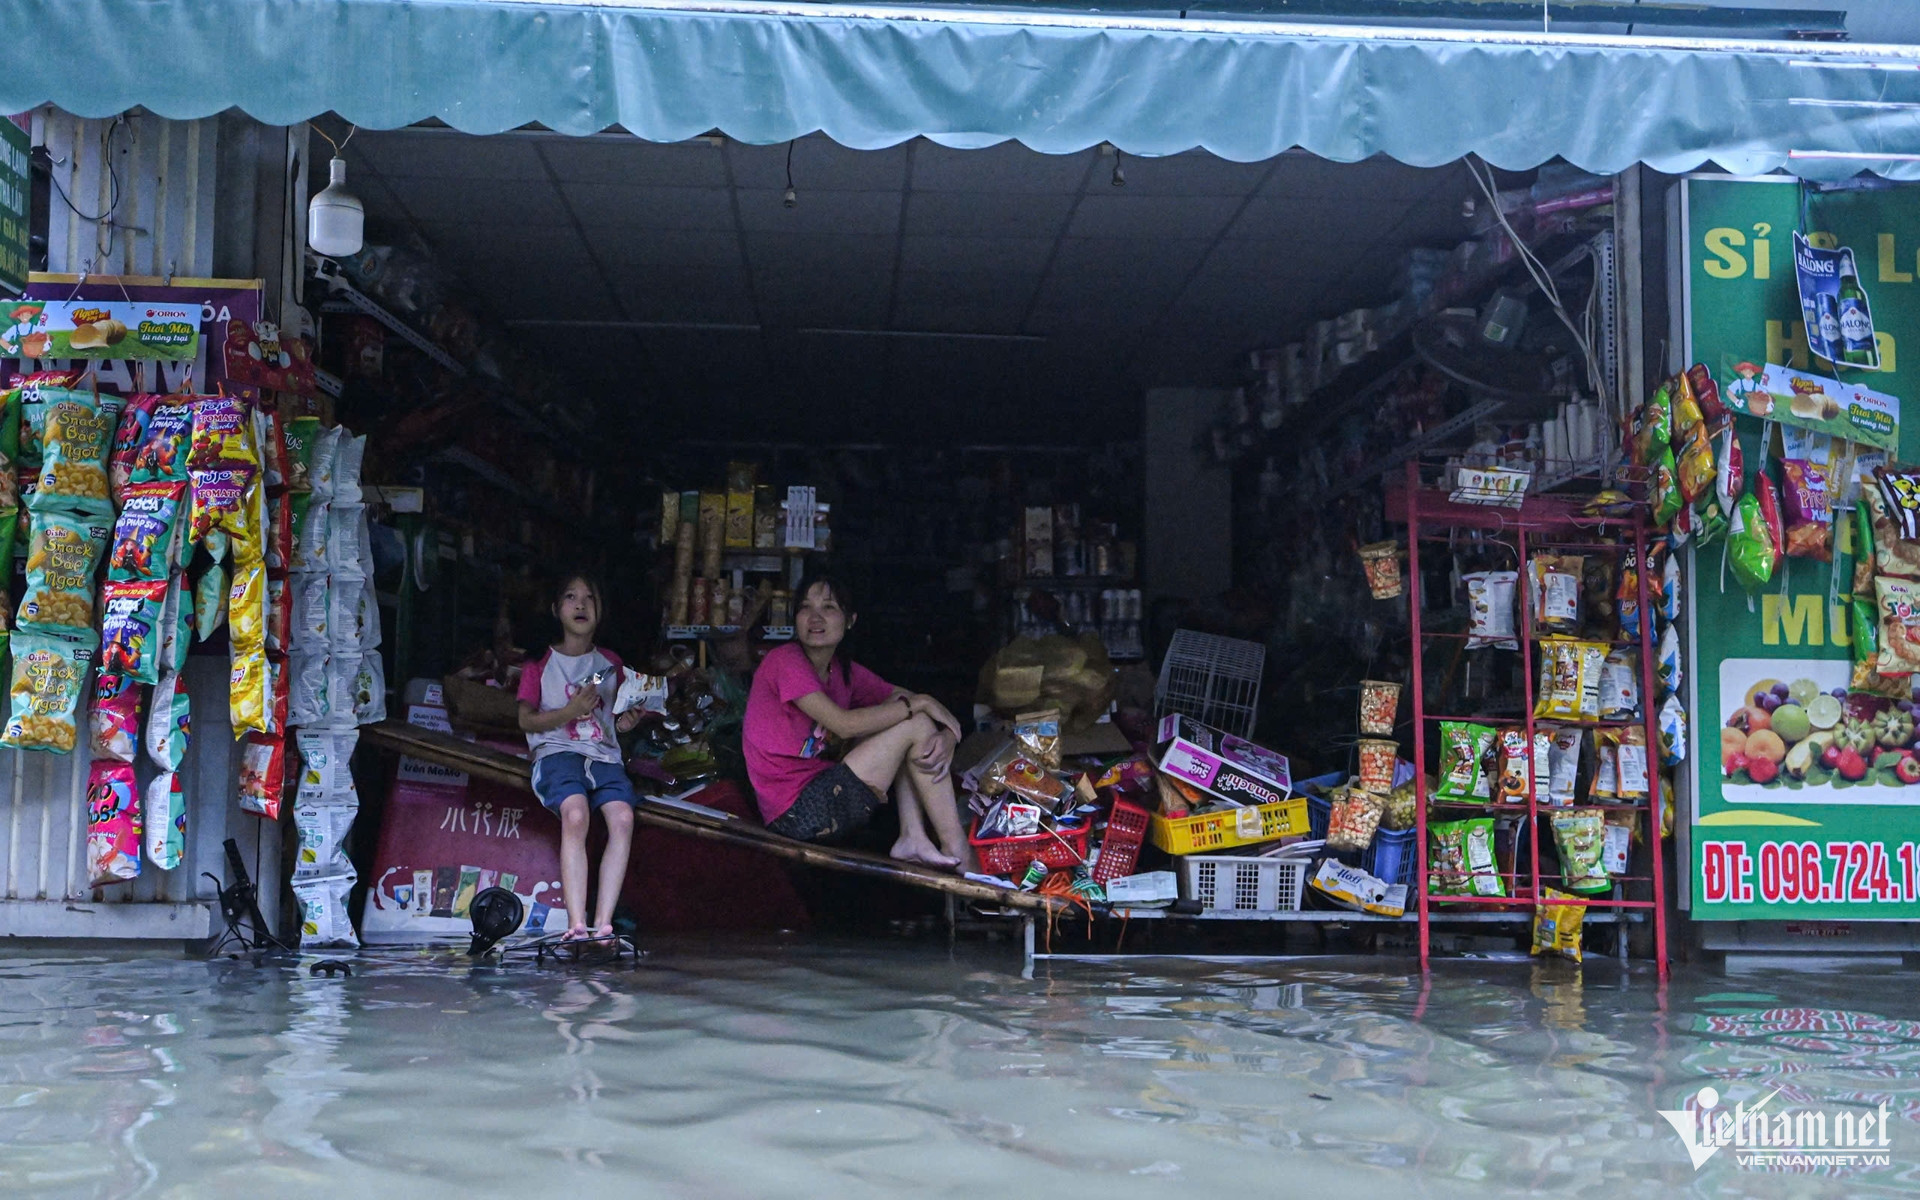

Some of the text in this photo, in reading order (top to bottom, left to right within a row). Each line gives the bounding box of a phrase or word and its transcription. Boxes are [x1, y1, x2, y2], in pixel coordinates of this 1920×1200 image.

[1703, 222, 1772, 280] Sỉ
[1797, 252, 1835, 274] HALONG
[57, 403, 80, 412] Oishi
[1860, 395, 1888, 409] ORION
[58, 412, 107, 431] Snack
[200, 414, 243, 423] TOMATO
[198, 489, 241, 499] TOMATO
[123, 498, 159, 512] POCA
[44, 539, 94, 557] Snack
[28, 653, 49, 661] Oishi
[1228, 773, 1280, 804] Omachi
[1703, 842, 1920, 902] ĐT: 096.724.1
